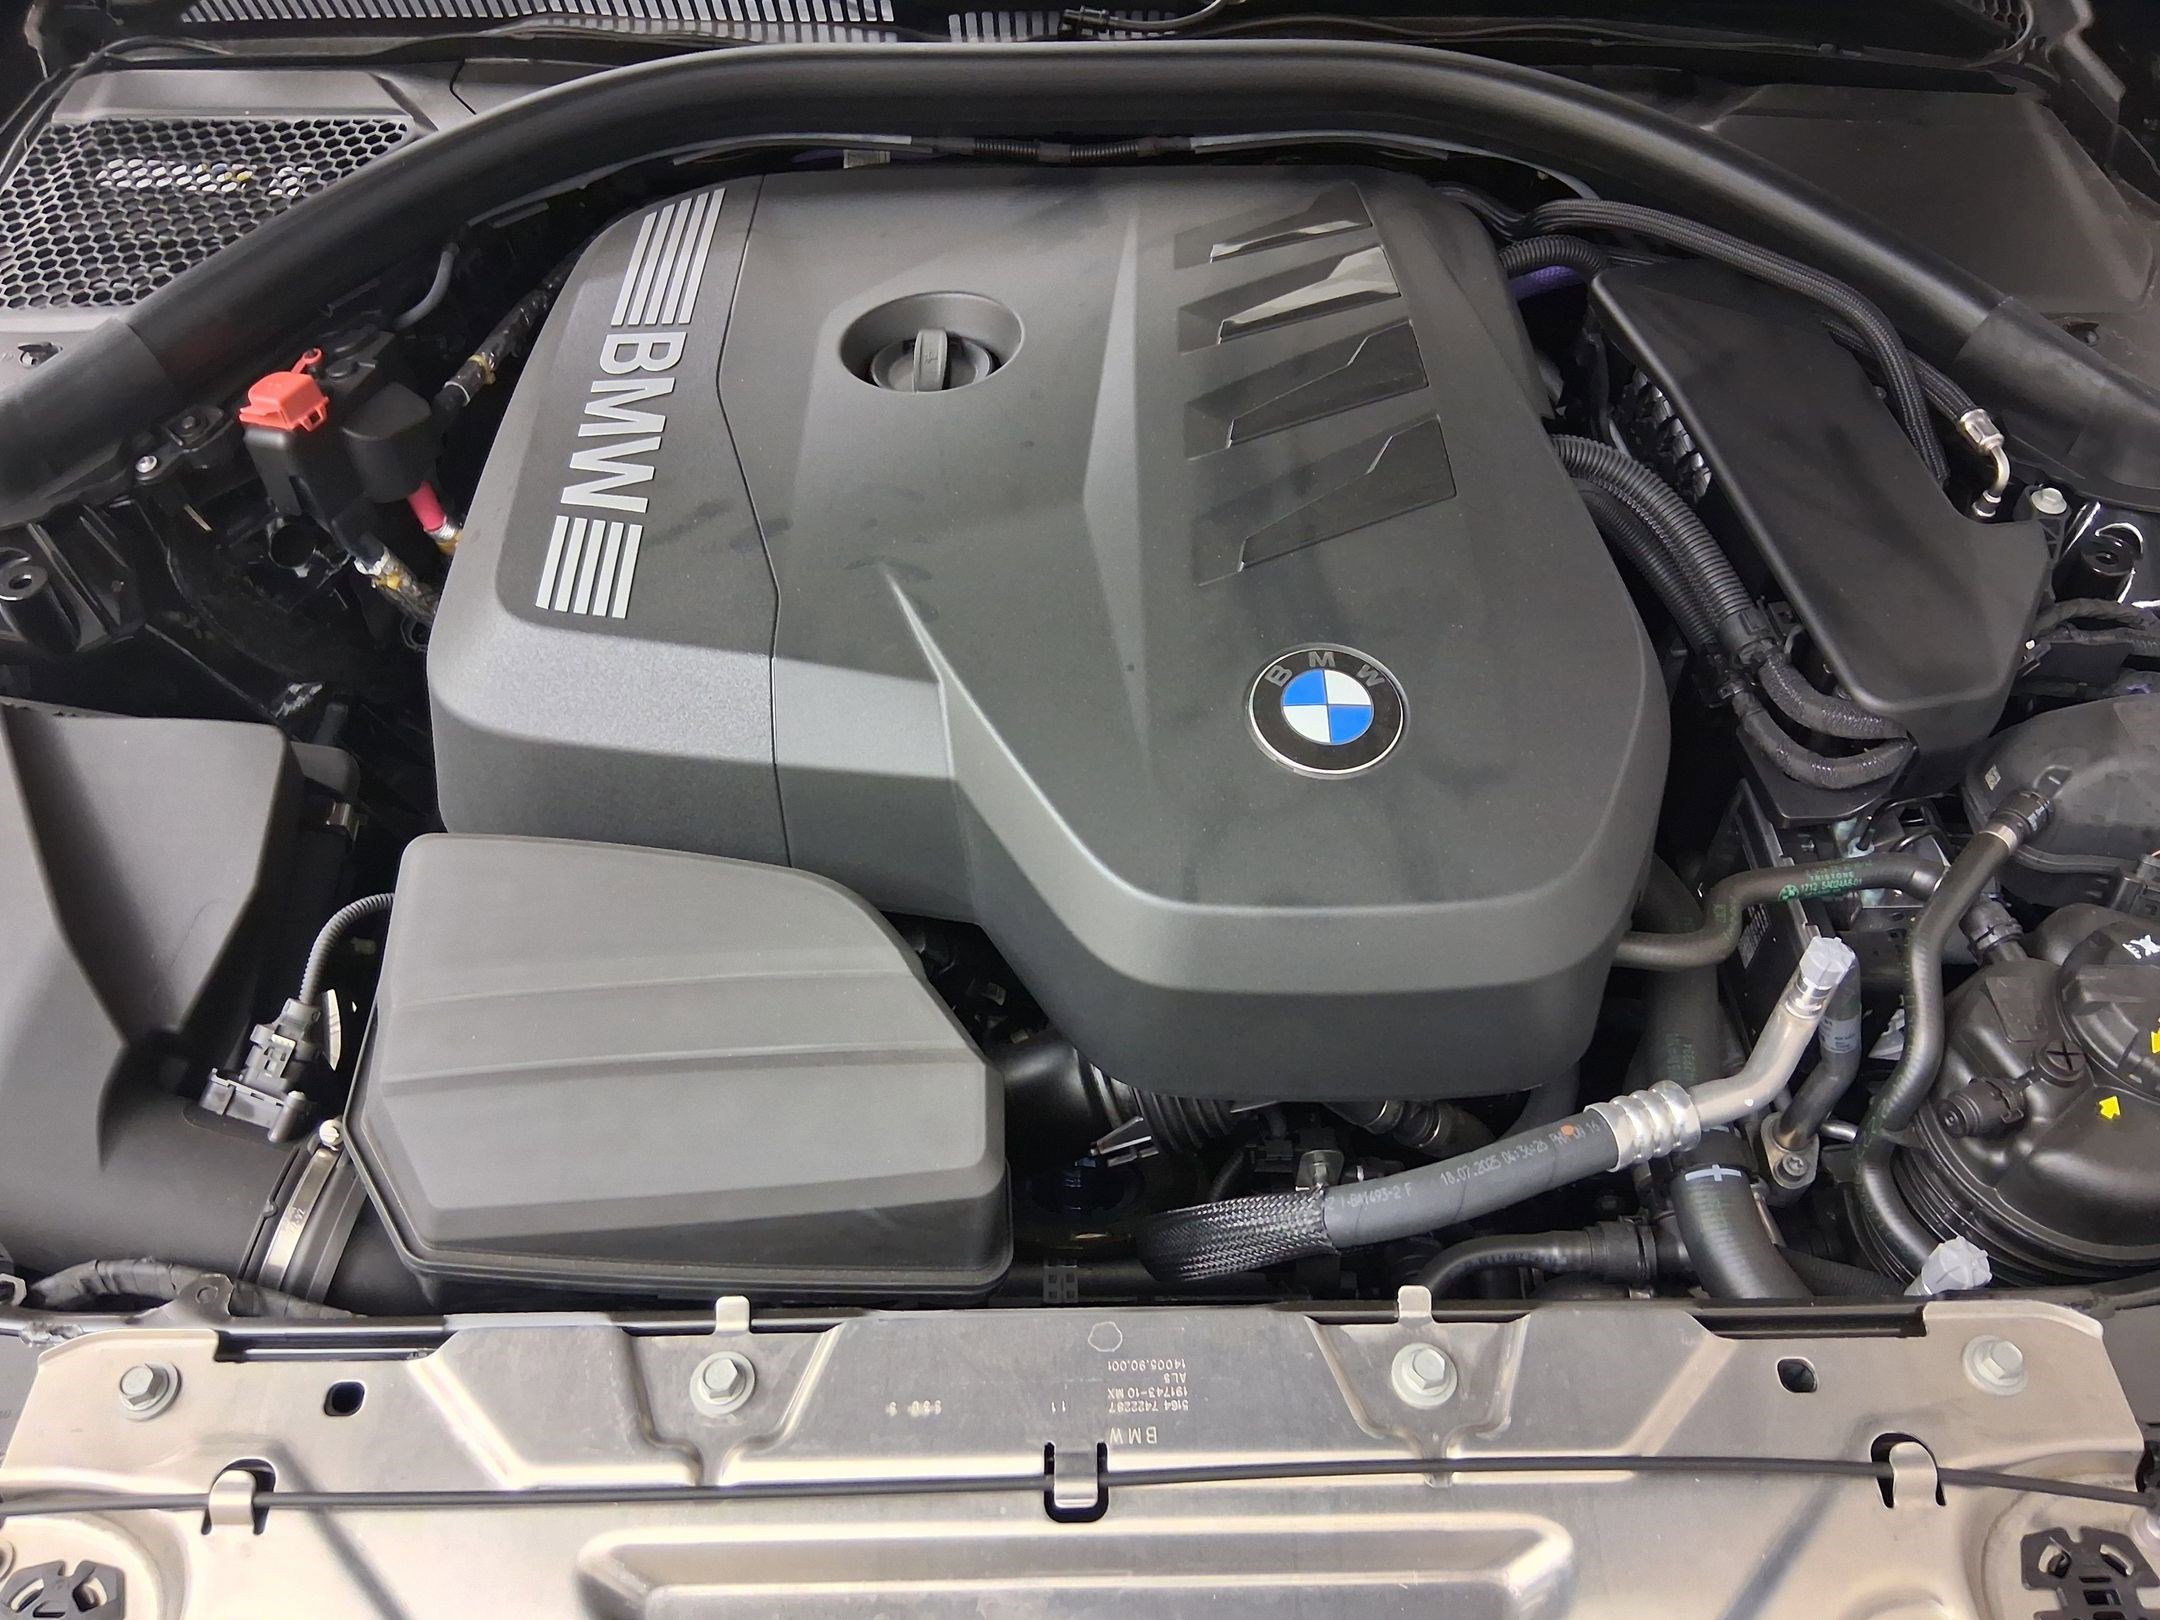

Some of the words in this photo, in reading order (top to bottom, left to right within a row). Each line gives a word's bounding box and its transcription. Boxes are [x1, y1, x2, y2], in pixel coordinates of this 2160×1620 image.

[561, 332, 687, 513] BMW
[1265, 651, 1385, 688] BMW
[1164, 1400, 1189, 1411] 5164
[1109, 1426, 1158, 1445] BMW
